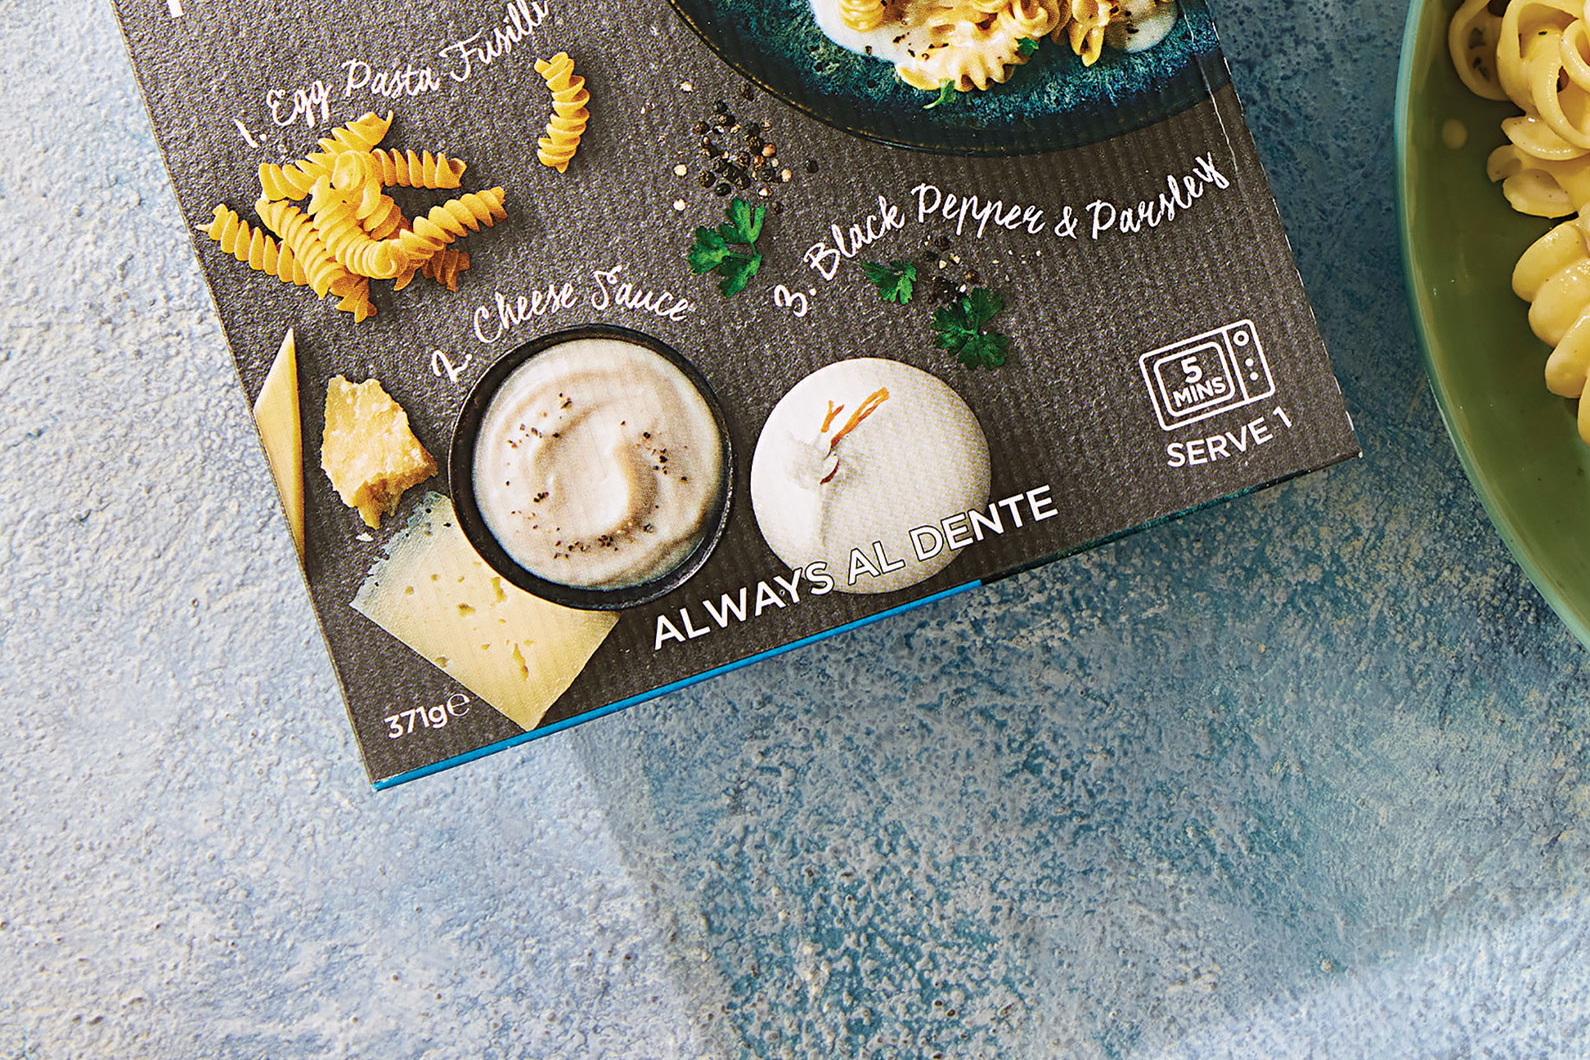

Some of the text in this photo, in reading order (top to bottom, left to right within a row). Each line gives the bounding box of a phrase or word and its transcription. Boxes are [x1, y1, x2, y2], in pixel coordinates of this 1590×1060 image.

[233, 118, 267, 147] 1.
[266, 78, 332, 128] Egg
[340, 56, 441, 99] Pasta
[774, 151, 1230, 317] 3. Black Pepper & Parsley
[431, 265, 691, 383] 2. Cheese Sauce
[1180, 355, 1203, 384] 5
[1166, 405, 1292, 468] SERVE 1
[1172, 376, 1227, 407] MINS
[653, 484, 1059, 650] ALWAYS AL DENTE
